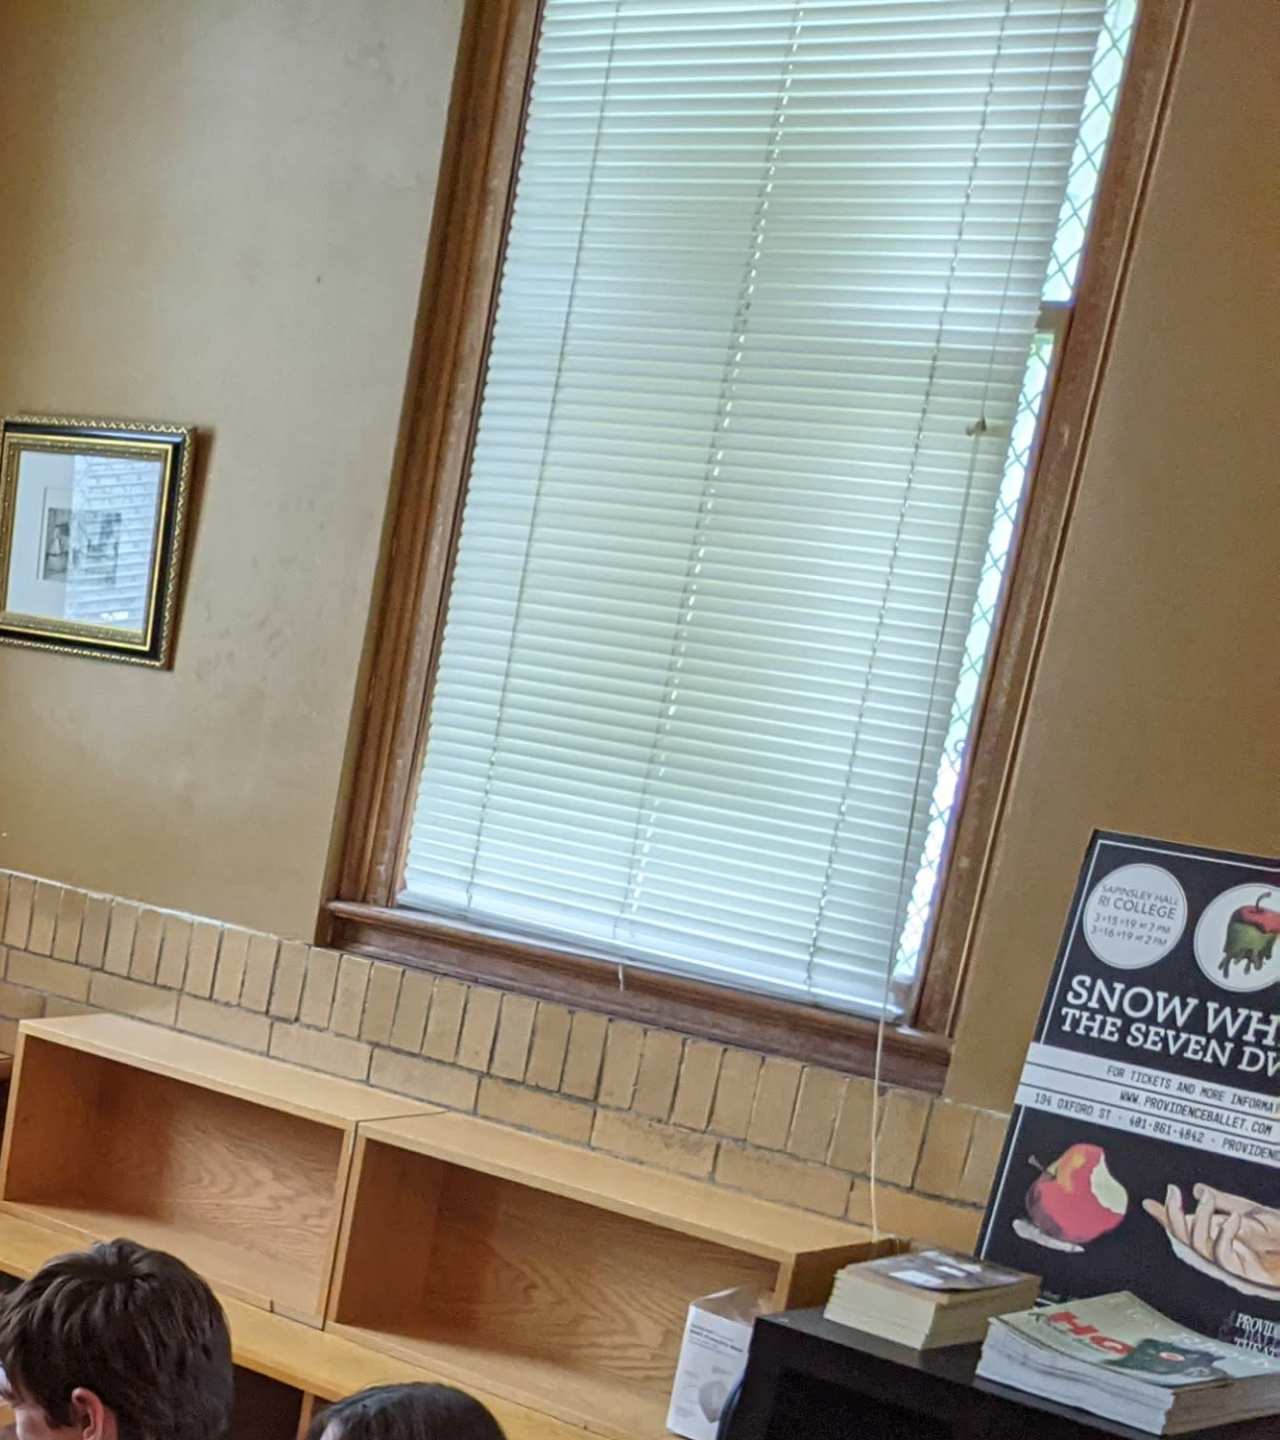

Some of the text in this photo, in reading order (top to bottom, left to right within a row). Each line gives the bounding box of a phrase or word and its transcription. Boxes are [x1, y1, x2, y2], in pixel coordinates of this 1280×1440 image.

[1113, 897, 1177, 920] COLLEGE
[1066, 974, 1280, 1047] SNOW WH
[1060, 1007, 1123, 1043] THE
[1126, 1022, 1234, 1068] SEVEN
[1106, 1065, 1125, 1079] FOR
[1130, 1070, 1172, 1090] TICKETS
[1177, 1081, 1196, 1095] AND
[1200, 1086, 1225, 1102] MORE
[1057, 1097, 1095, 1117] OXFORD
[1099, 1108, 1112, 1121] ST
